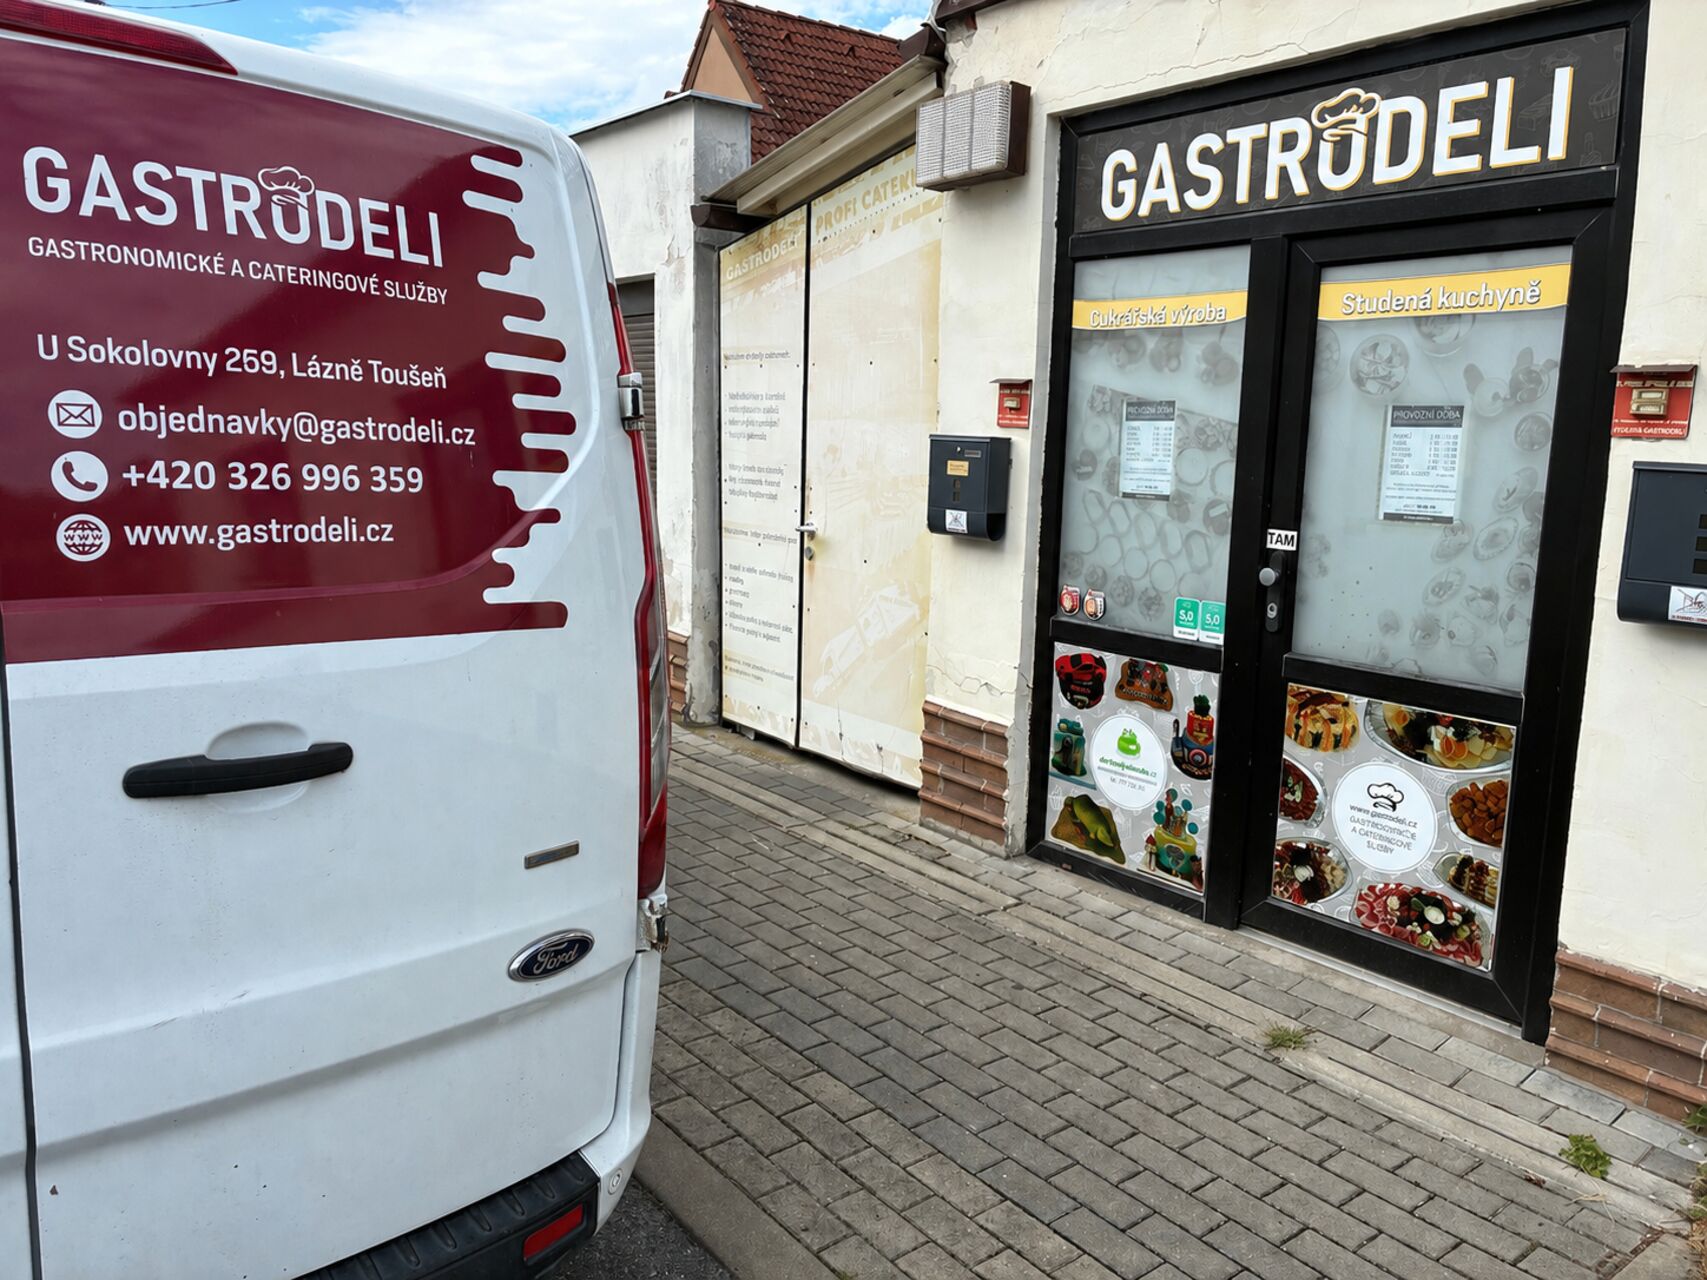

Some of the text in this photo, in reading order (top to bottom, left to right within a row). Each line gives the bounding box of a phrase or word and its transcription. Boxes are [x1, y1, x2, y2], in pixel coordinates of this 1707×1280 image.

[1101, 66, 1574, 221] GASTRODELI
[22, 146, 444, 268] GASTRODELI
[815, 205, 858, 236] PROFI
[28, 236, 448, 305] GASTRONOMICKÉ A CATERINGOVÉ SLUŽBY
[1090, 302, 1226, 328] Cukrářská výroba
[1341, 280, 1542, 316] Studená kuchyně
[37, 334, 59, 360] U
[67, 335, 218, 376] Sokolovny
[292, 353, 364, 382] Lázně
[368, 361, 447, 389] Toušeň
[118, 403, 476, 446] objednavky@gastrodeli.cz
[122, 461, 424, 493] +420 326 996 359
[124, 517, 394, 550] www.gastrodeli.cz
[1269, 532, 1295, 547] TAM
[533, 943, 578, 974] Ford
